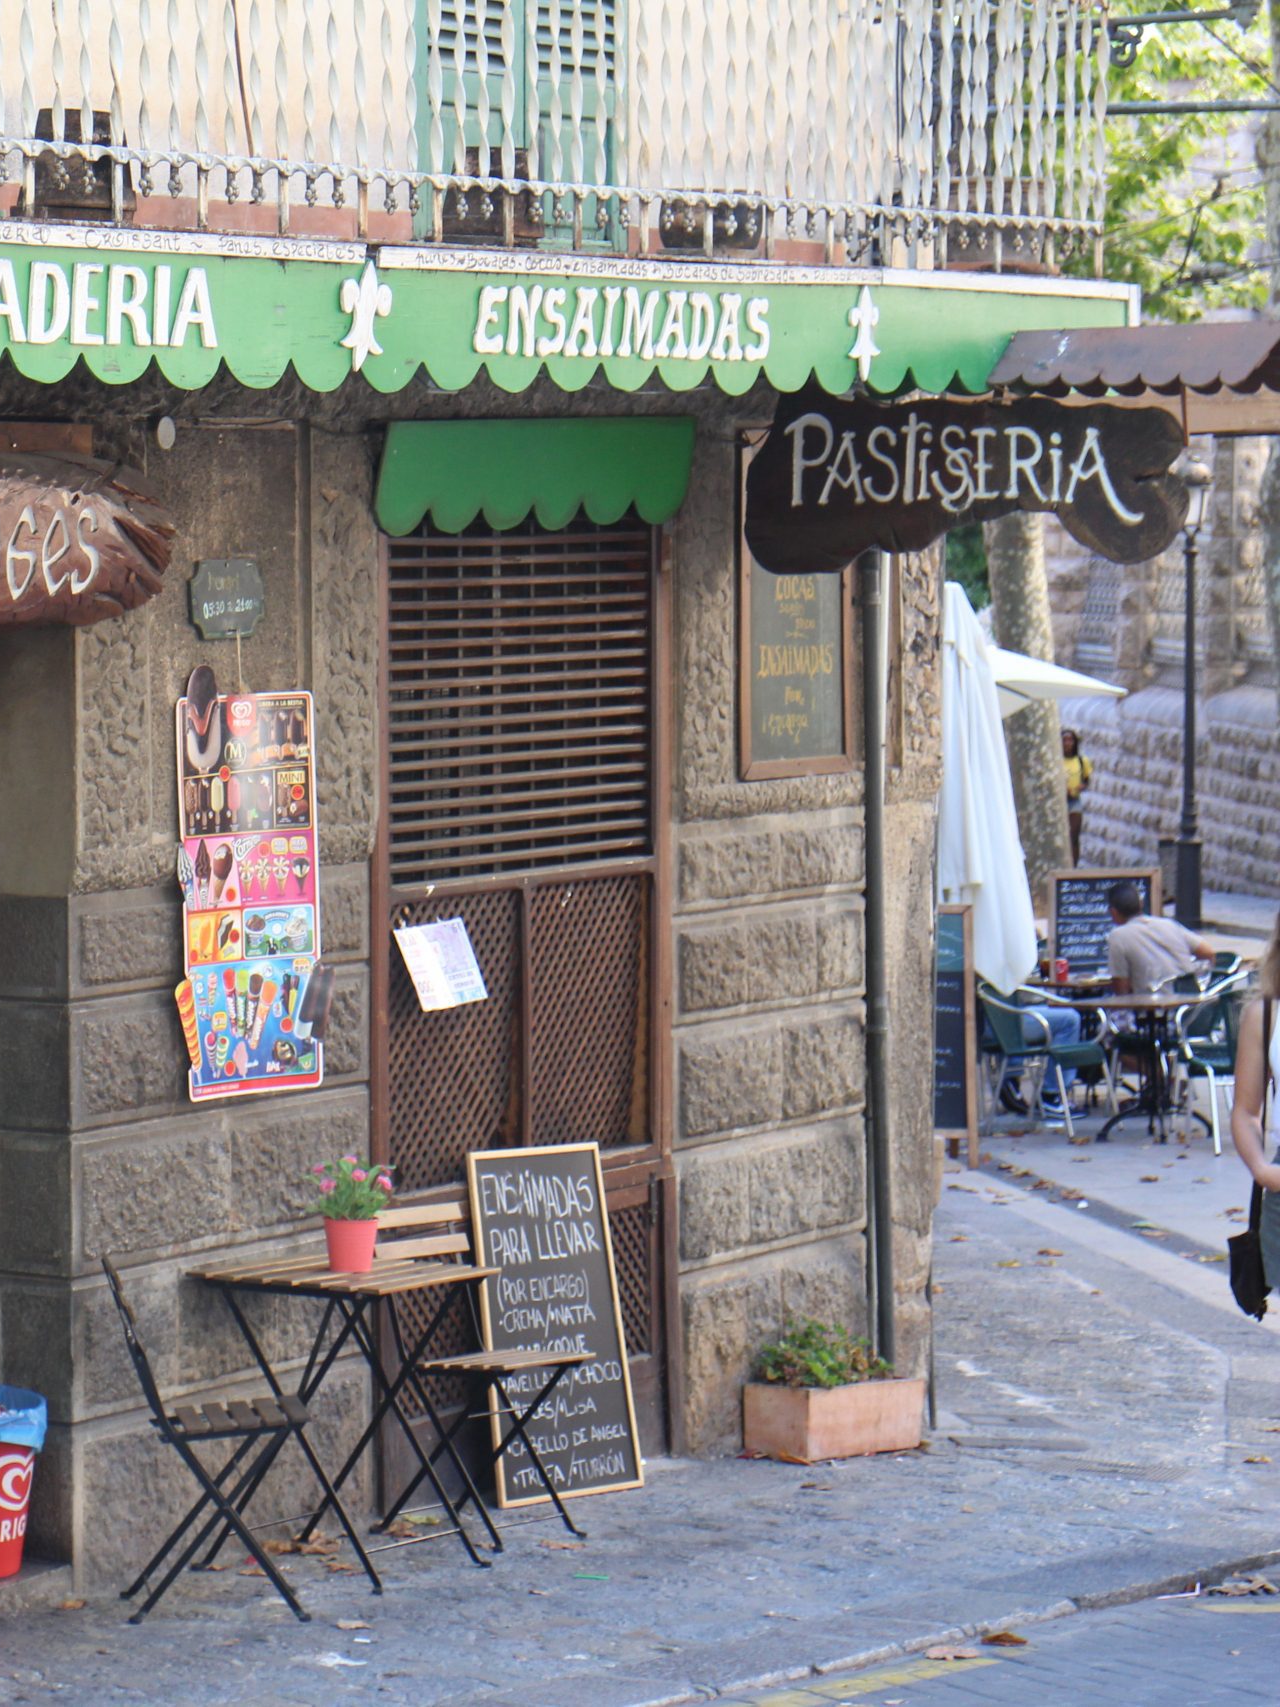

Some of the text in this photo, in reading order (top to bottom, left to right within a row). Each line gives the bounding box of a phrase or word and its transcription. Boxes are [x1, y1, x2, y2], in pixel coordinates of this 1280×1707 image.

[473, 284, 770, 361] ENSAIMADAS
[279, 771, 305, 783] MINI
[490, 1221, 600, 1265] PARA LLEVAR
[507, 1361, 622, 1394] AVELLAA CHOCO
[572, 1428, 588, 1446] DE
